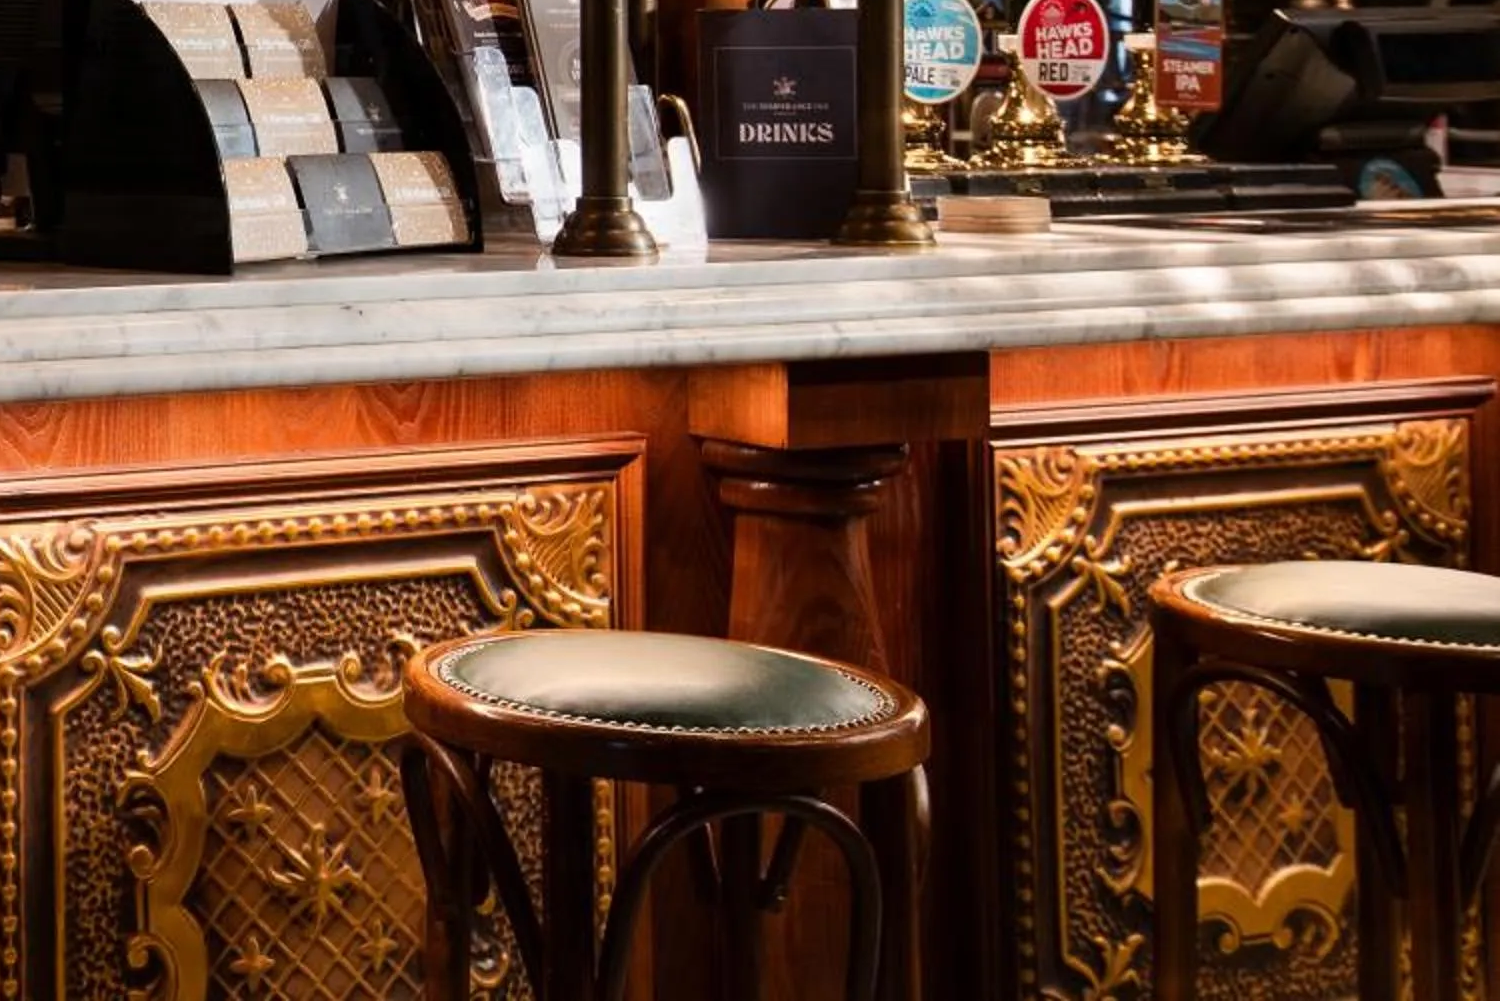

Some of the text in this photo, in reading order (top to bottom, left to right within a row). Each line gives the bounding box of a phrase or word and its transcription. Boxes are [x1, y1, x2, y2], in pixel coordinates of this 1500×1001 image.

[904, 25, 965, 41] HAWKS
[1035, 21, 1094, 42] HAWKS
[904, 40, 965, 61] HEAD
[1036, 38, 1094, 60] HEAD
[905, 64, 936, 86] PALE
[1038, 61, 1069, 82] RED
[1163, 58, 1215, 75] STEAMER
[1175, 73, 1201, 93] IPA
[739, 122, 834, 144] DRINKS
